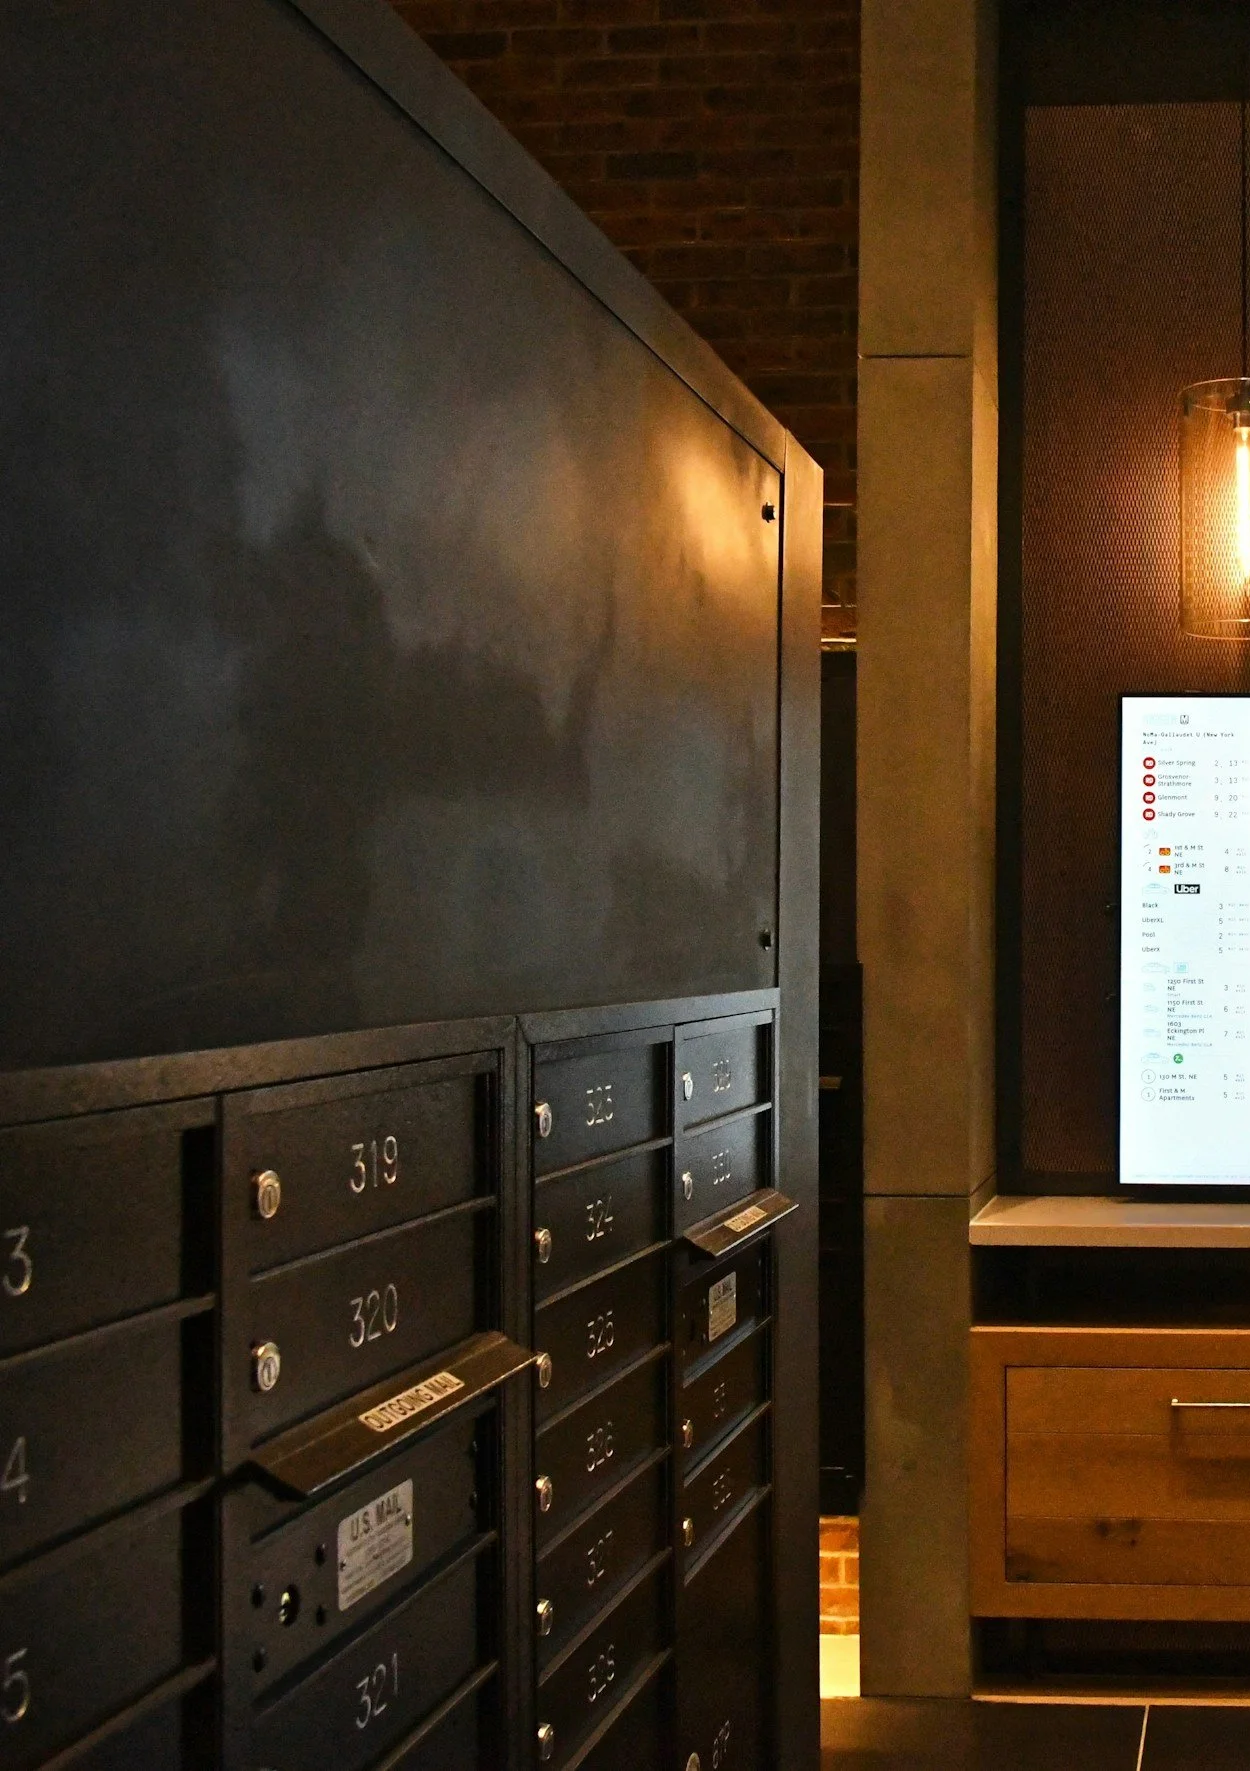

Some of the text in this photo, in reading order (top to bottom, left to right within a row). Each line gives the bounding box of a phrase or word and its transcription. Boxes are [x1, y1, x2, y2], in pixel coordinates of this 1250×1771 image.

[1176, 760, 1196, 768] Spring
[1176, 885, 1198, 893] Uber
[1167, 1028, 1197, 1036] Eckington
[1223, 1005, 1229, 1013] 6
[349, 1135, 399, 1194] 319
[1, 1225, 33, 1298] 3
[349, 1283, 399, 1348] 320
[364, 1375, 461, 1429] OUTGOING MAIL
[1, 1437, 30, 1502] 4
[376, 1492, 401, 1526] MAIL
[1, 1649, 30, 1722] 5
[355, 1653, 399, 1728] 321
